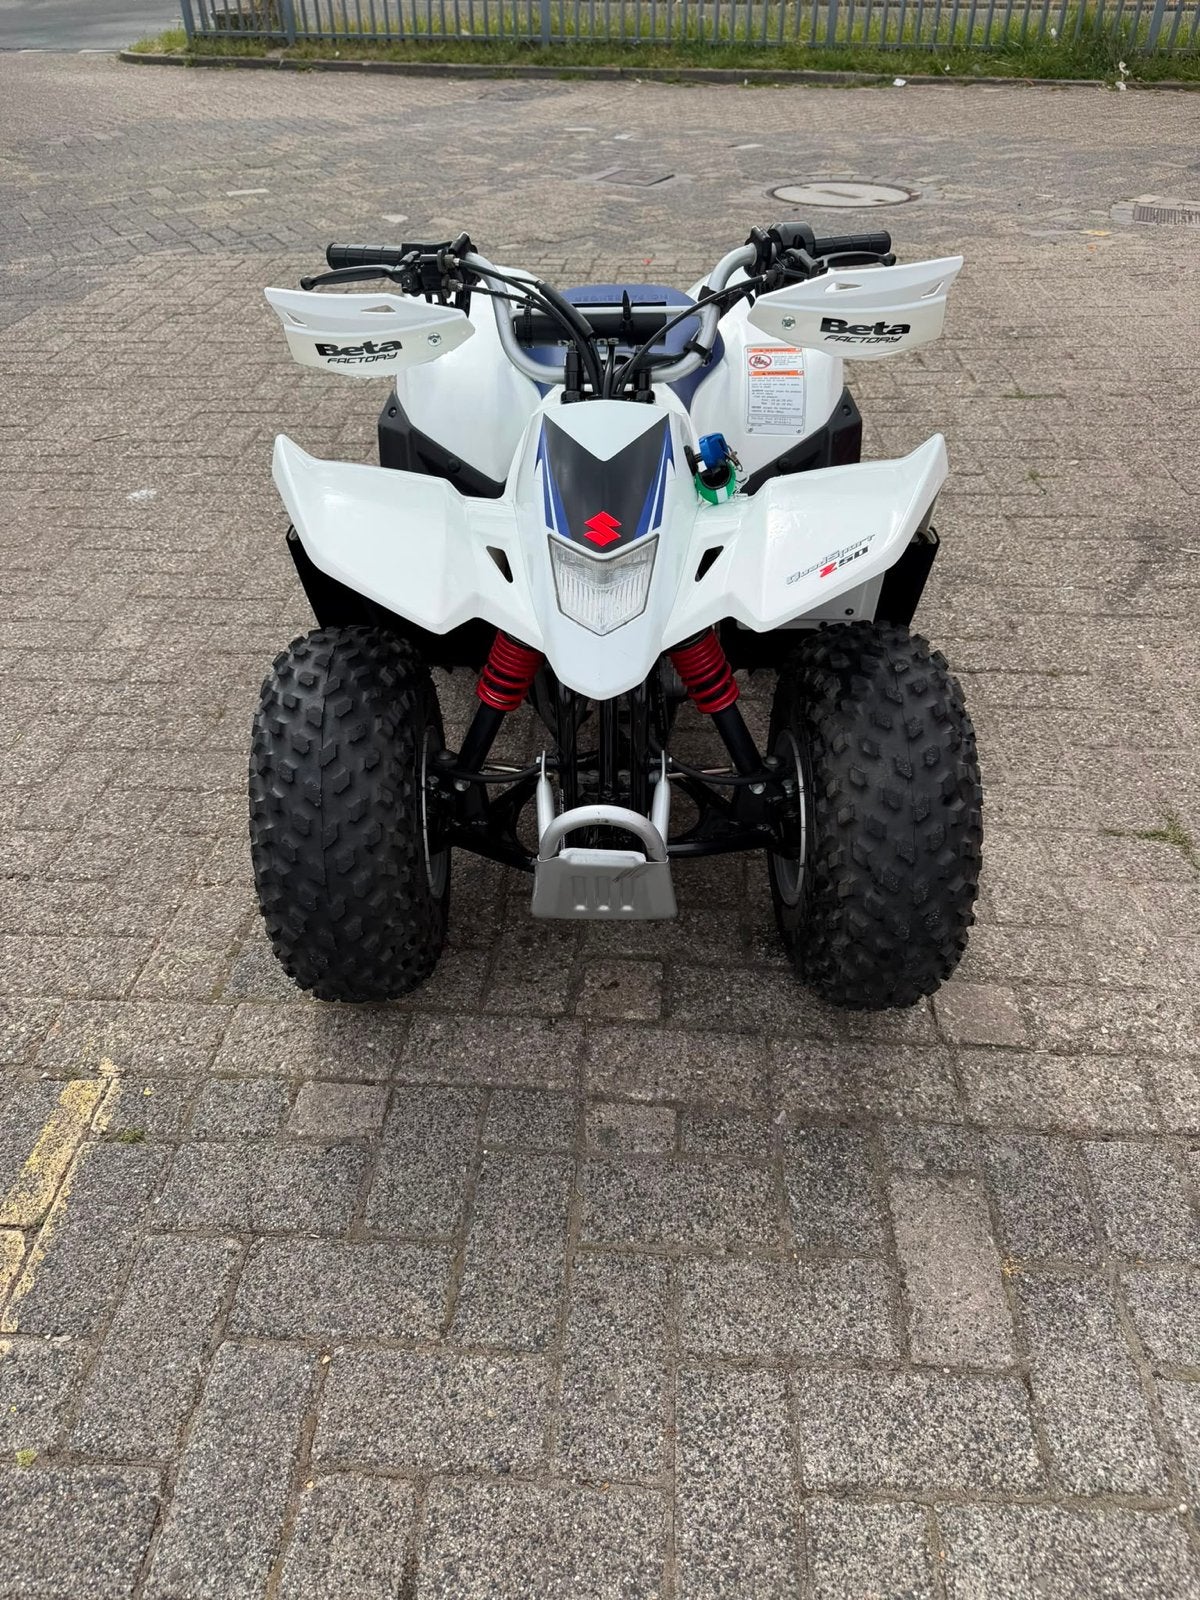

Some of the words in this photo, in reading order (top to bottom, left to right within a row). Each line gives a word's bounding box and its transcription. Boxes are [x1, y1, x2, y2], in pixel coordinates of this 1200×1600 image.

[820, 317, 911, 335] Beta
[824, 335, 903, 344] FACTORY
[314, 340, 403, 357] Beta
[327, 352, 398, 364] FACTORY
[819, 546, 869, 578] Z50
